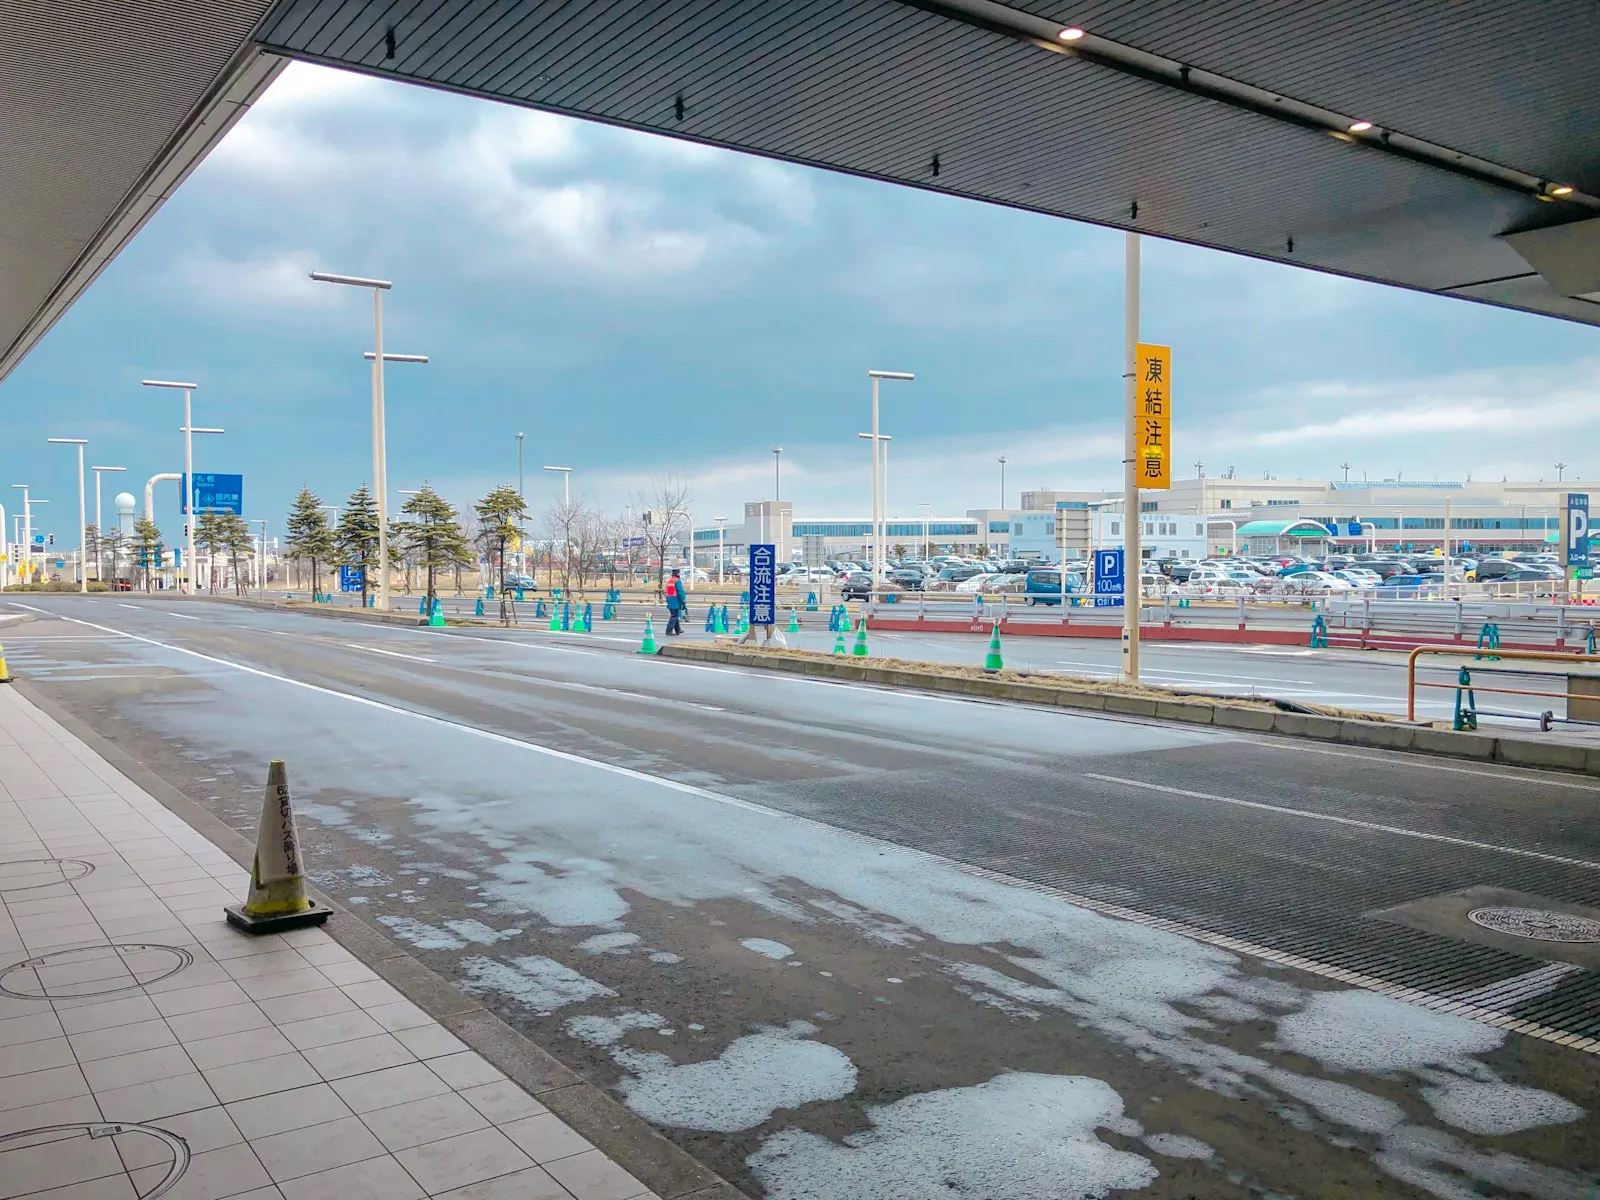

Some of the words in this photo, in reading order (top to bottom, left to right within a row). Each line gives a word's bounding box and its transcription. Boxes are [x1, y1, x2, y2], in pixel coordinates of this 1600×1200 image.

[1145, 357, 1163, 478] 凍結注意
[1570, 509, 1587, 549] P
[753, 547, 771, 622] 合流注意
[1104, 555, 1115, 575] P
